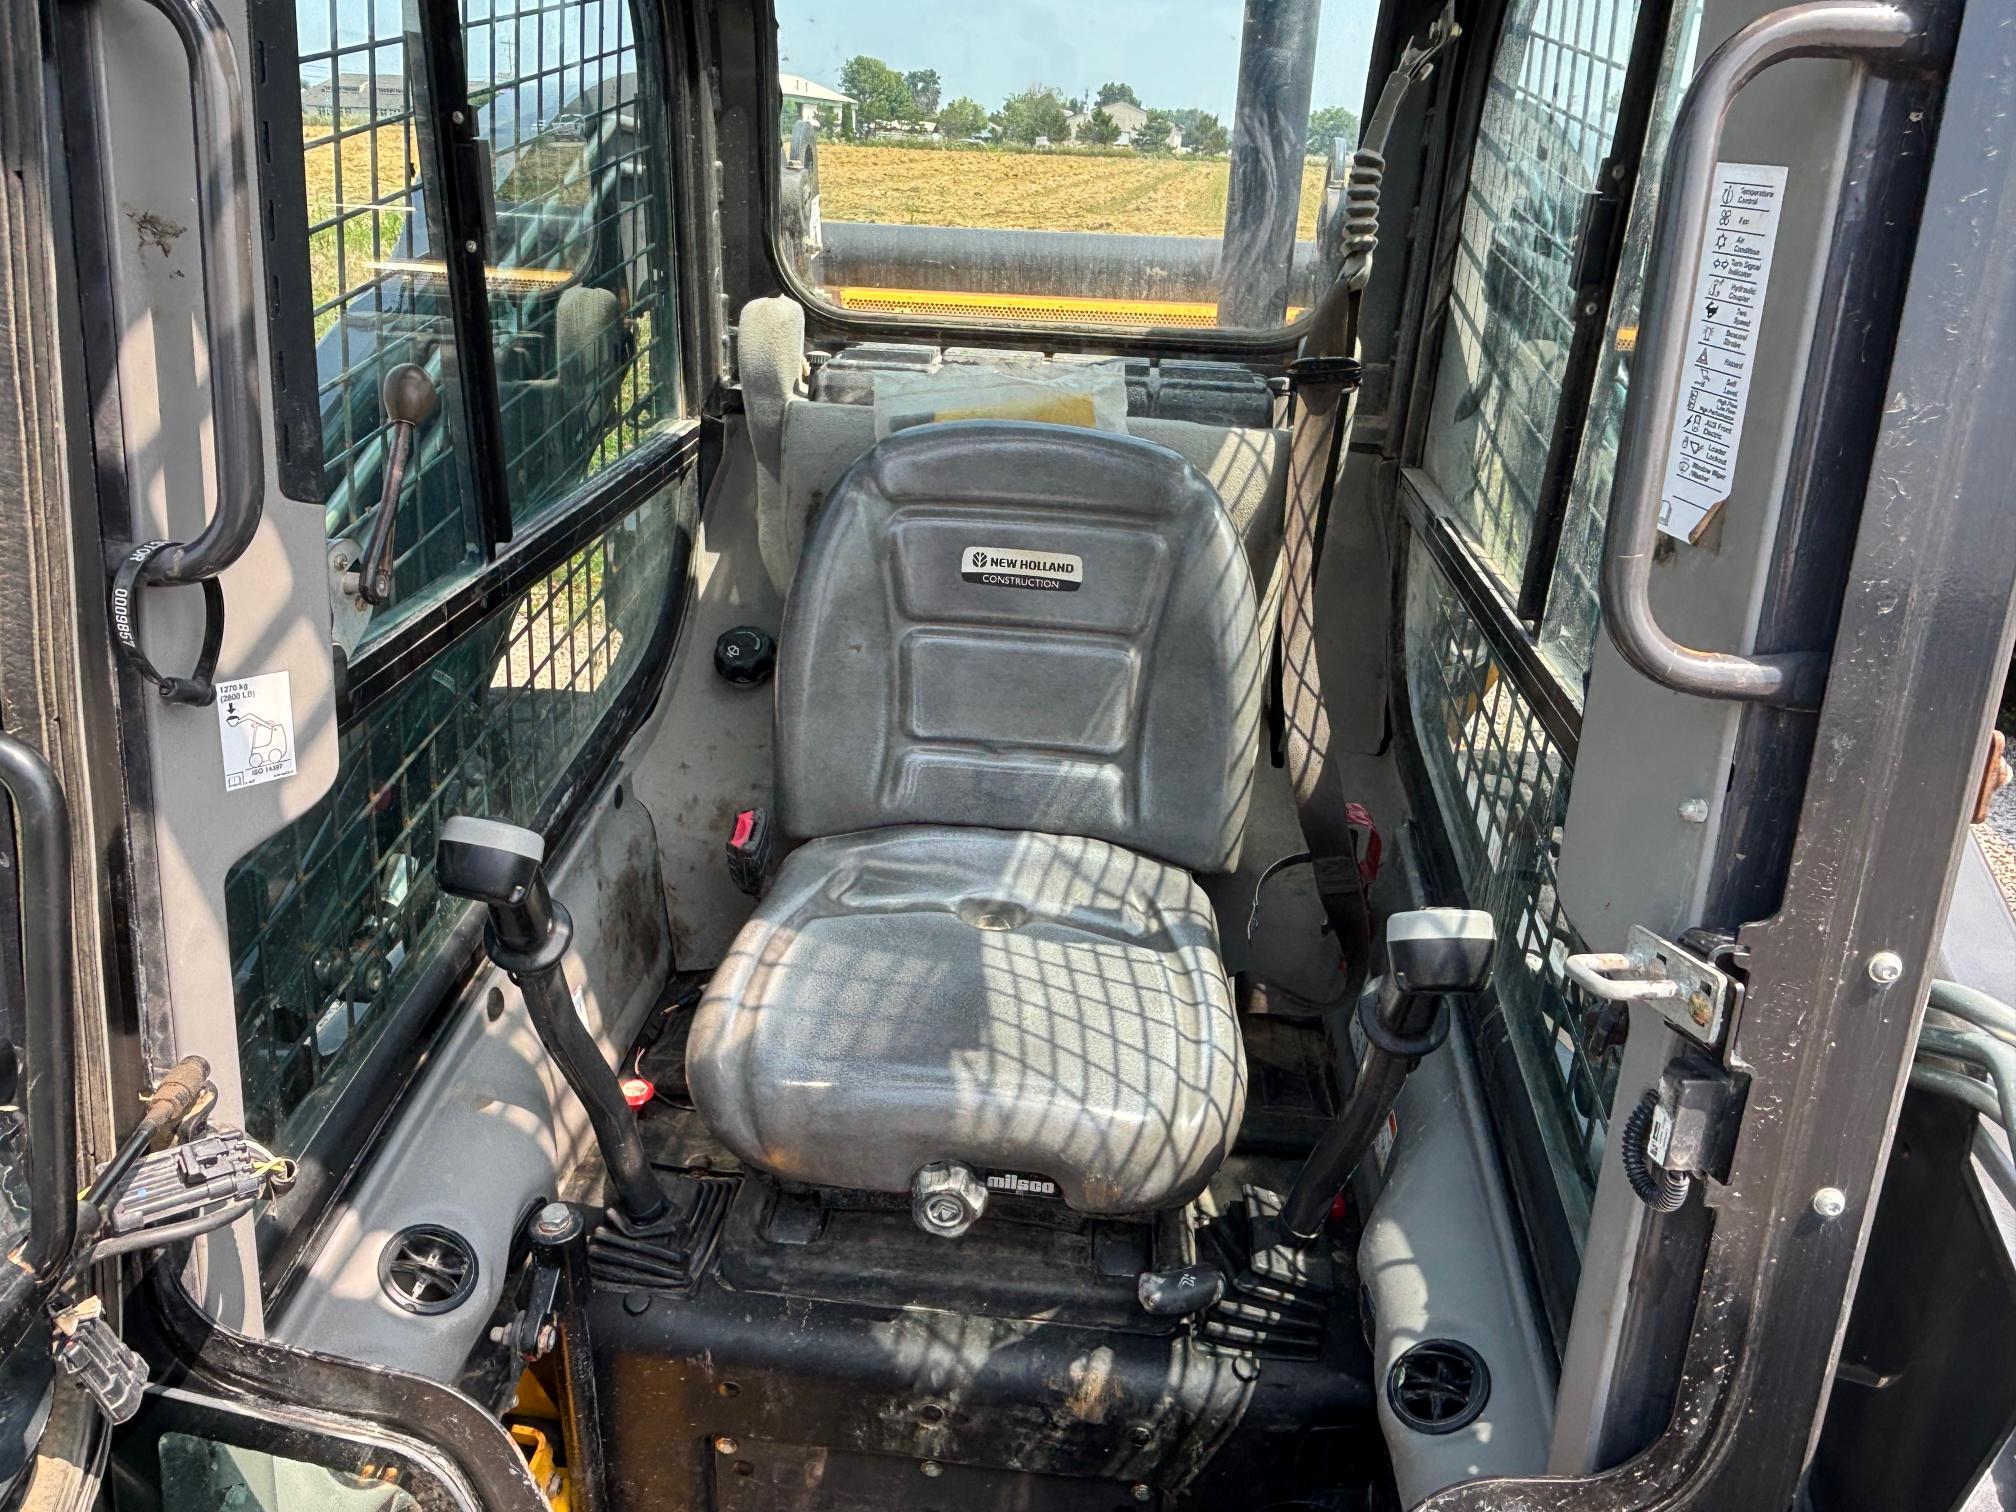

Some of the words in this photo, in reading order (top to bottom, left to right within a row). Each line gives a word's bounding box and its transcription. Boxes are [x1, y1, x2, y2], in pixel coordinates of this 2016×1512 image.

[1741, 187, 1774, 197] Temperature
[1738, 196, 1758, 204] Control
[1744, 261, 1761, 270] Signal
[1728, 268, 1752, 278] Indicator
[1731, 284, 1756, 295] Hydraulic
[1728, 292, 1750, 302] Coupler
[1724, 359, 1744, 369] Hazard
[1708, 444, 1726, 456] Loader
[1706, 453, 1727, 465] Lockout
[990, 558, 1017, 568] NEW
[1020, 560, 1074, 573] HOLLAND
[983, 575, 1059, 588] CONSTRUCTION
[115, 588, 135, 648] 0009857
[220, 685, 237, 693] 1270
[220, 693, 240, 704] (2800
[252, 768, 264, 776] ISO
[987, 1174, 1055, 1194] milsco
